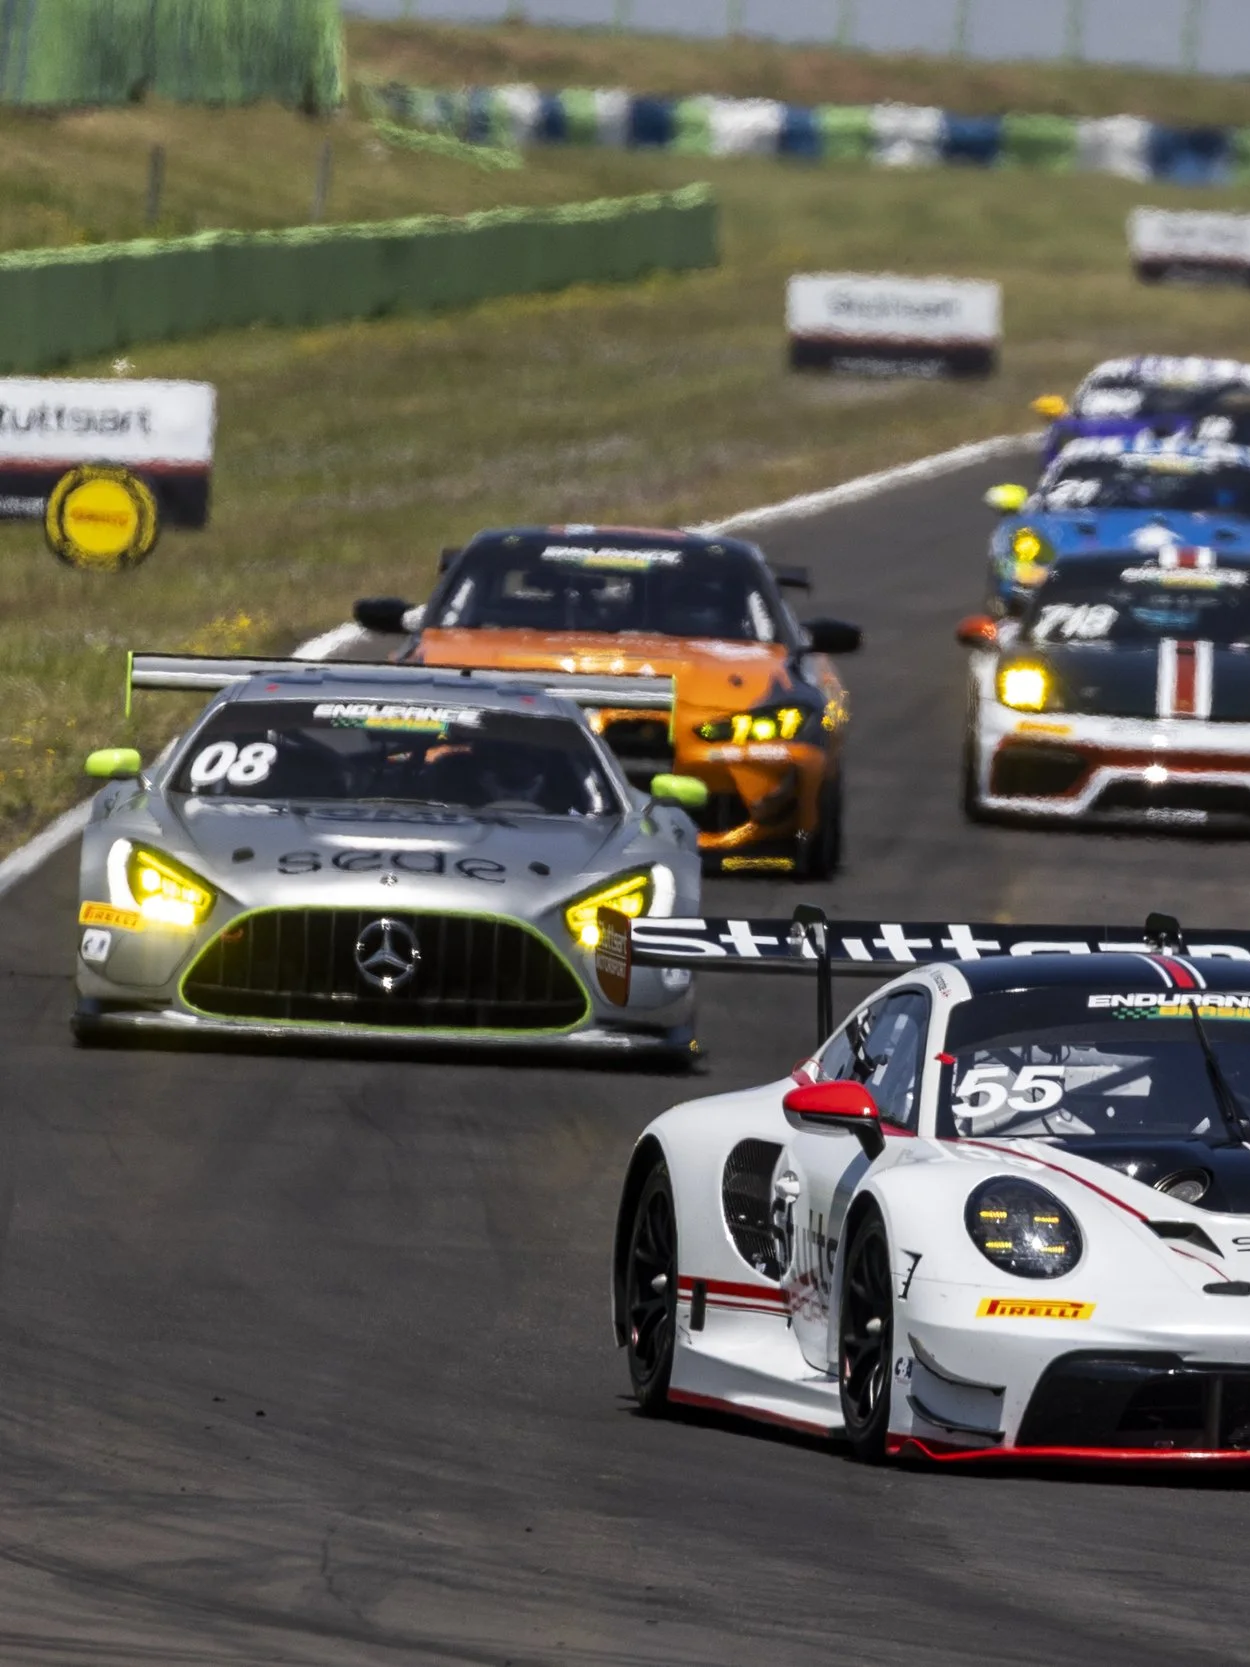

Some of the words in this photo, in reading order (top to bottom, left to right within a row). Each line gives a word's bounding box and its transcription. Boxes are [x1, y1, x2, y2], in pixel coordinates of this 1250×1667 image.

[190, 740, 277, 786] 08
[951, 1065, 1065, 1118] 55
[986, 1299, 1084, 1318] PIRELLI
